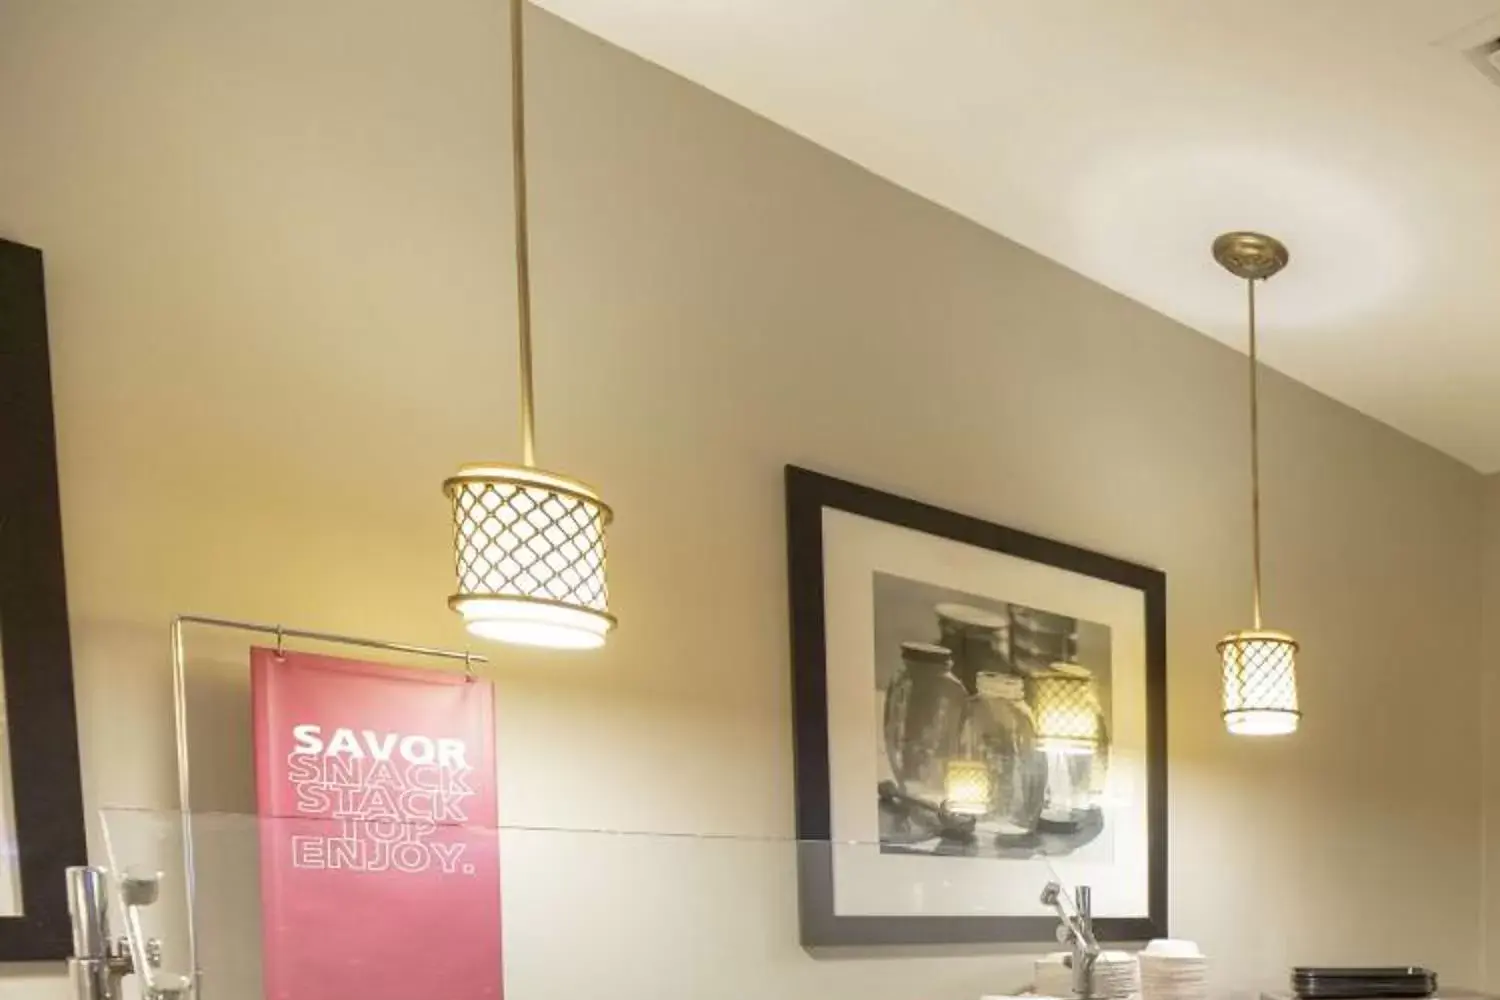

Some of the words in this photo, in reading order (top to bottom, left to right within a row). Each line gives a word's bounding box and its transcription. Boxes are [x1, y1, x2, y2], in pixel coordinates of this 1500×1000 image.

[291, 724, 473, 770] SAVOR
[288, 751, 475, 795] SNACK
[296, 781, 469, 821] STACK
[333, 812, 437, 844] TOP
[292, 836, 476, 874] ENJOY.
